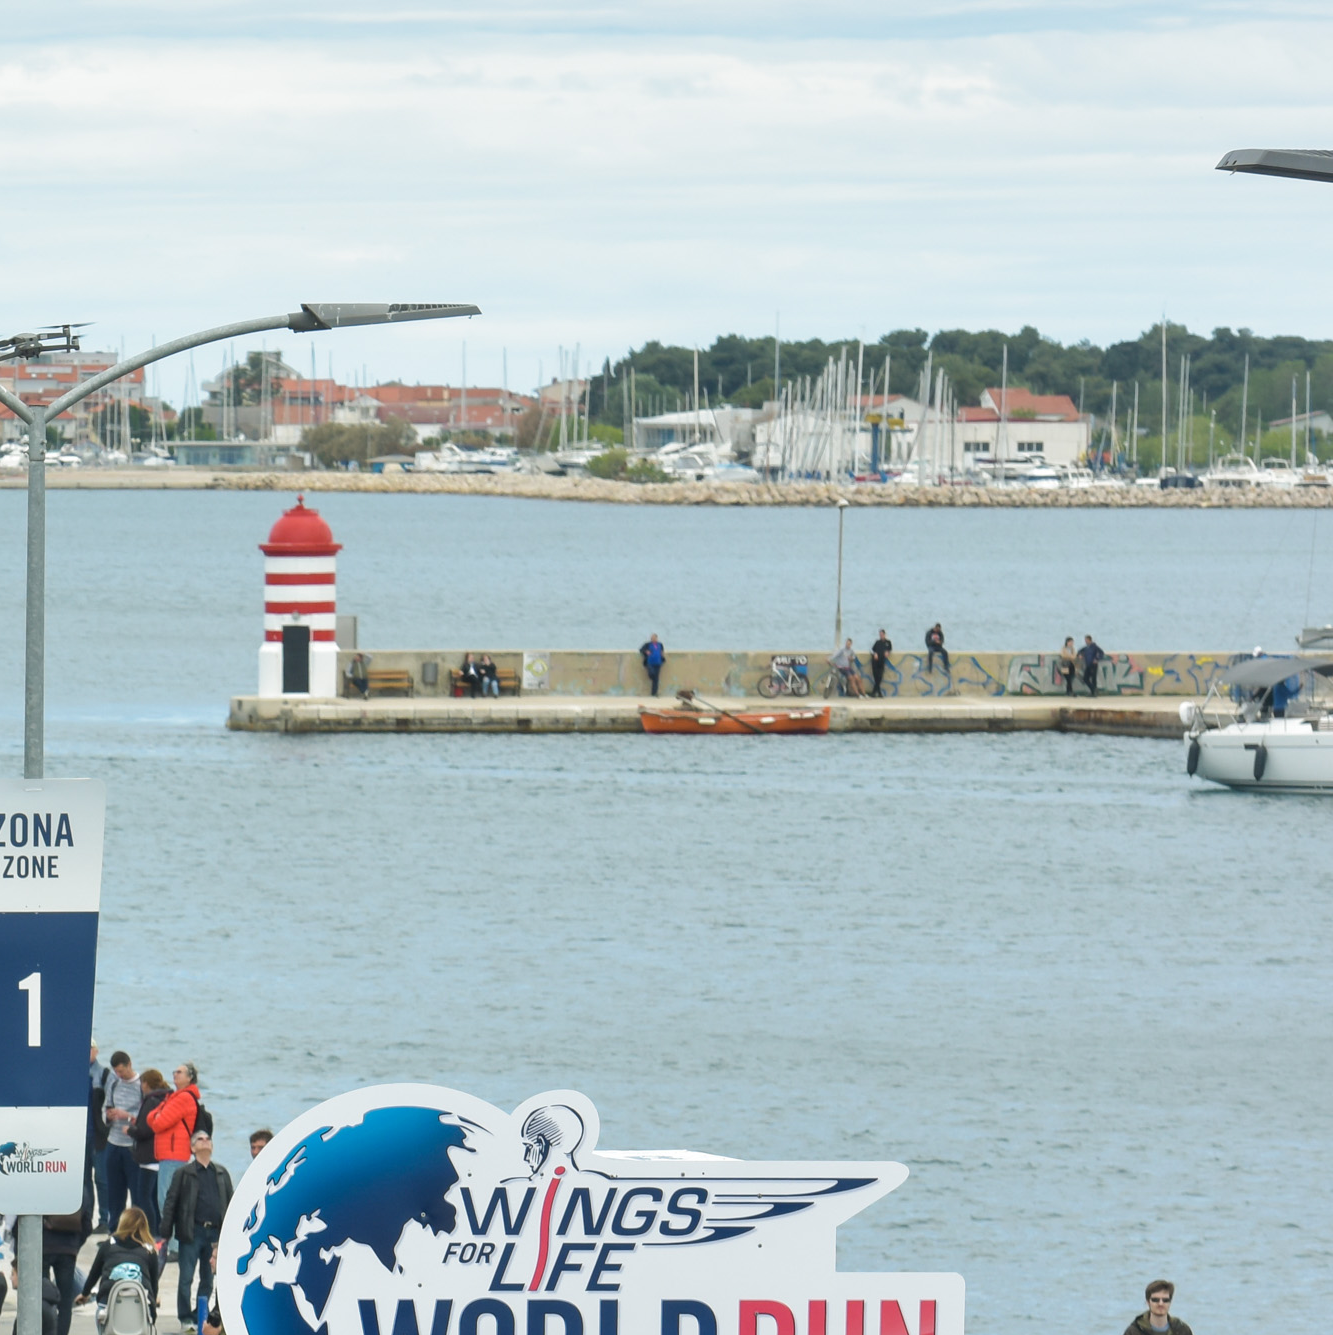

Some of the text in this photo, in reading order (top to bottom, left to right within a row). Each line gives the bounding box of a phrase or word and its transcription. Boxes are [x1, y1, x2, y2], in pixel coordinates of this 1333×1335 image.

[3, 855, 59, 879] ZONE
[18, 972, 41, 1047] 1
[6, 1160, 67, 1174] WORLD RUN
[459, 1185, 711, 1237] WINGS
[441, 1242, 642, 1293] FOR LIFE
